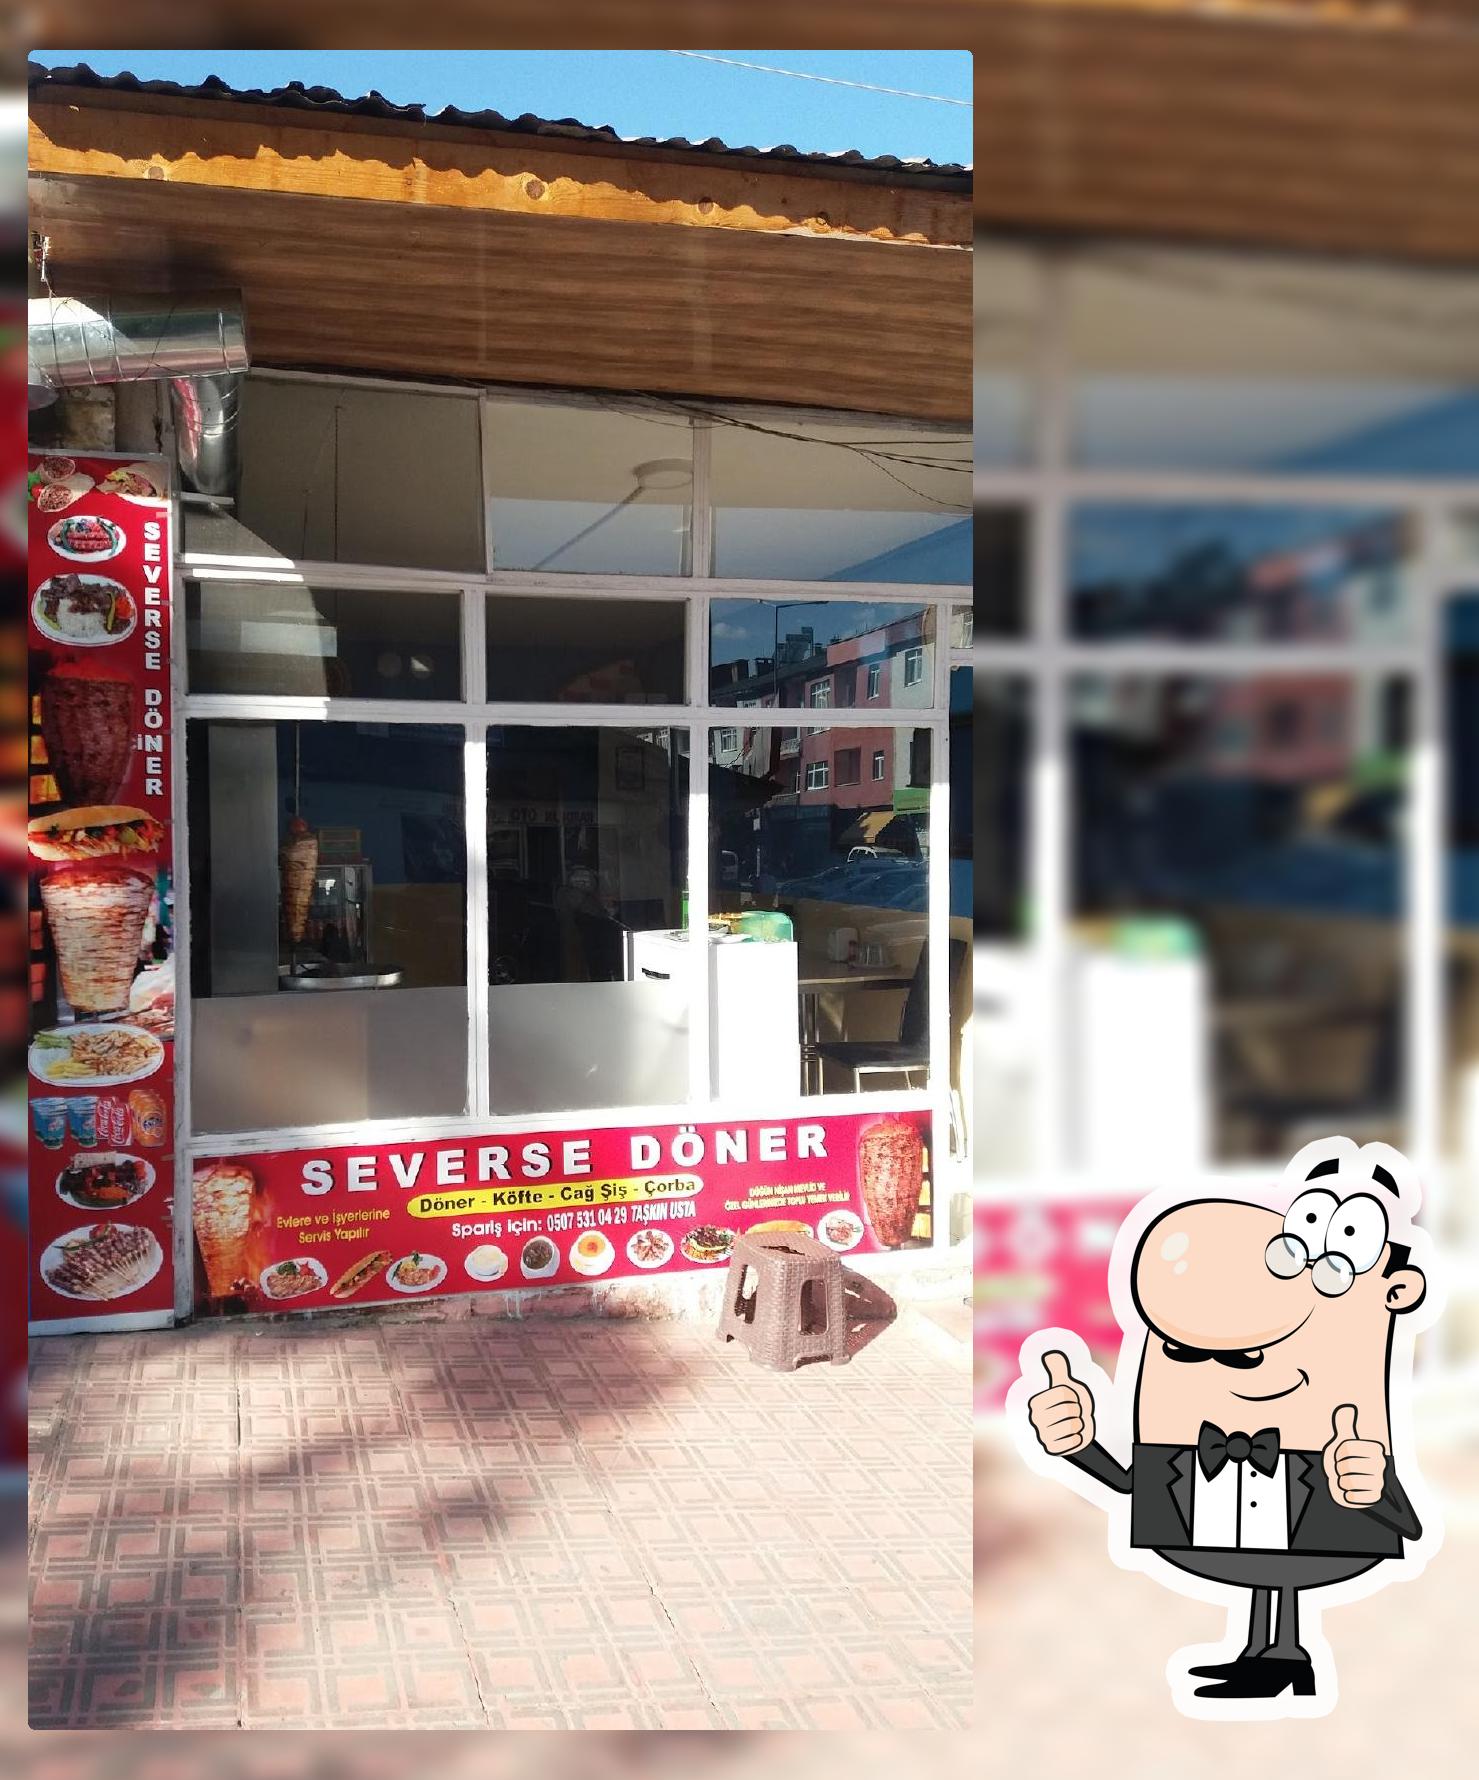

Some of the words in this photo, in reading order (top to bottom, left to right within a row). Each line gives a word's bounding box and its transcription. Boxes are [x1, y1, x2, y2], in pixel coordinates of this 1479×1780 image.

[142, 521, 163, 670] SEVERSE
[144, 688, 164, 796] DÖNER
[301, 1140, 592, 1196] SEVERSE
[630, 1124, 829, 1171] DÖNER
[419, 1195, 476, 1213] Döner
[492, 1187, 543, 1206] Köfte
[560, 1184, 595, 1203] Cağ
[600, 1179, 628, 1199] Şiş
[644, 1177, 696, 1197] Çorba
[276, 1215, 312, 1229] Evlere
[314, 1214, 330, 1226] ve
[546, 1212, 574, 1232] 0507
[576, 1209, 597, 1229] 531
[598, 1207, 612, 1226] 04
[613, 1205, 628, 1225] 29
[630, 1202, 669, 1227] TAŞKIN
[669, 1200, 697, 1219] USTA
[298, 1230, 332, 1244] Servis
